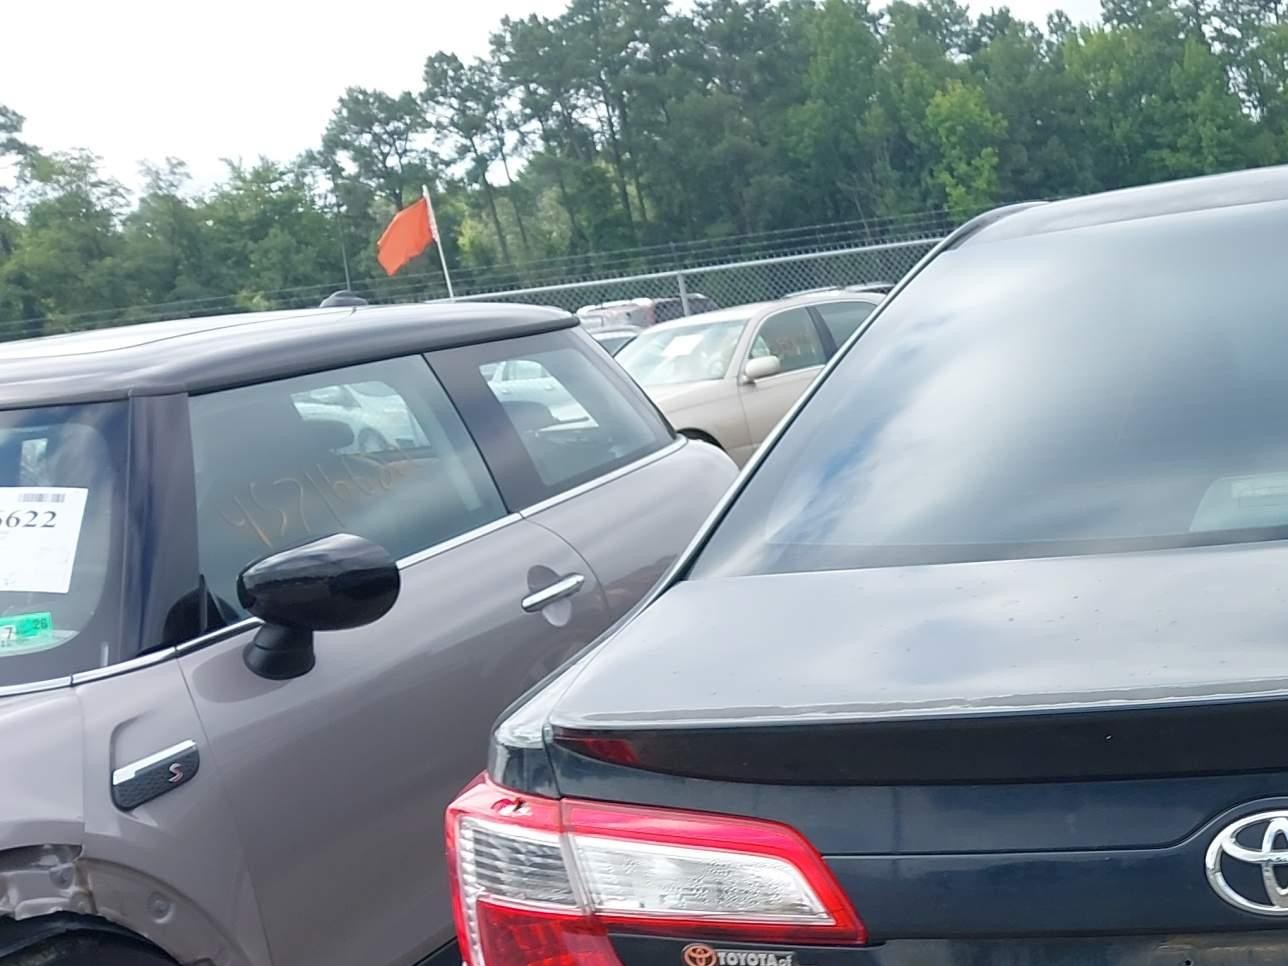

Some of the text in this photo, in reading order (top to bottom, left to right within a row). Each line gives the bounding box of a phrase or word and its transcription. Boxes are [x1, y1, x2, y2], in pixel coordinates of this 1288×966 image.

[0, 510, 56, 528] 622
[169, 763, 183, 783] S
[717, 951, 778, 966] TOYOTA
